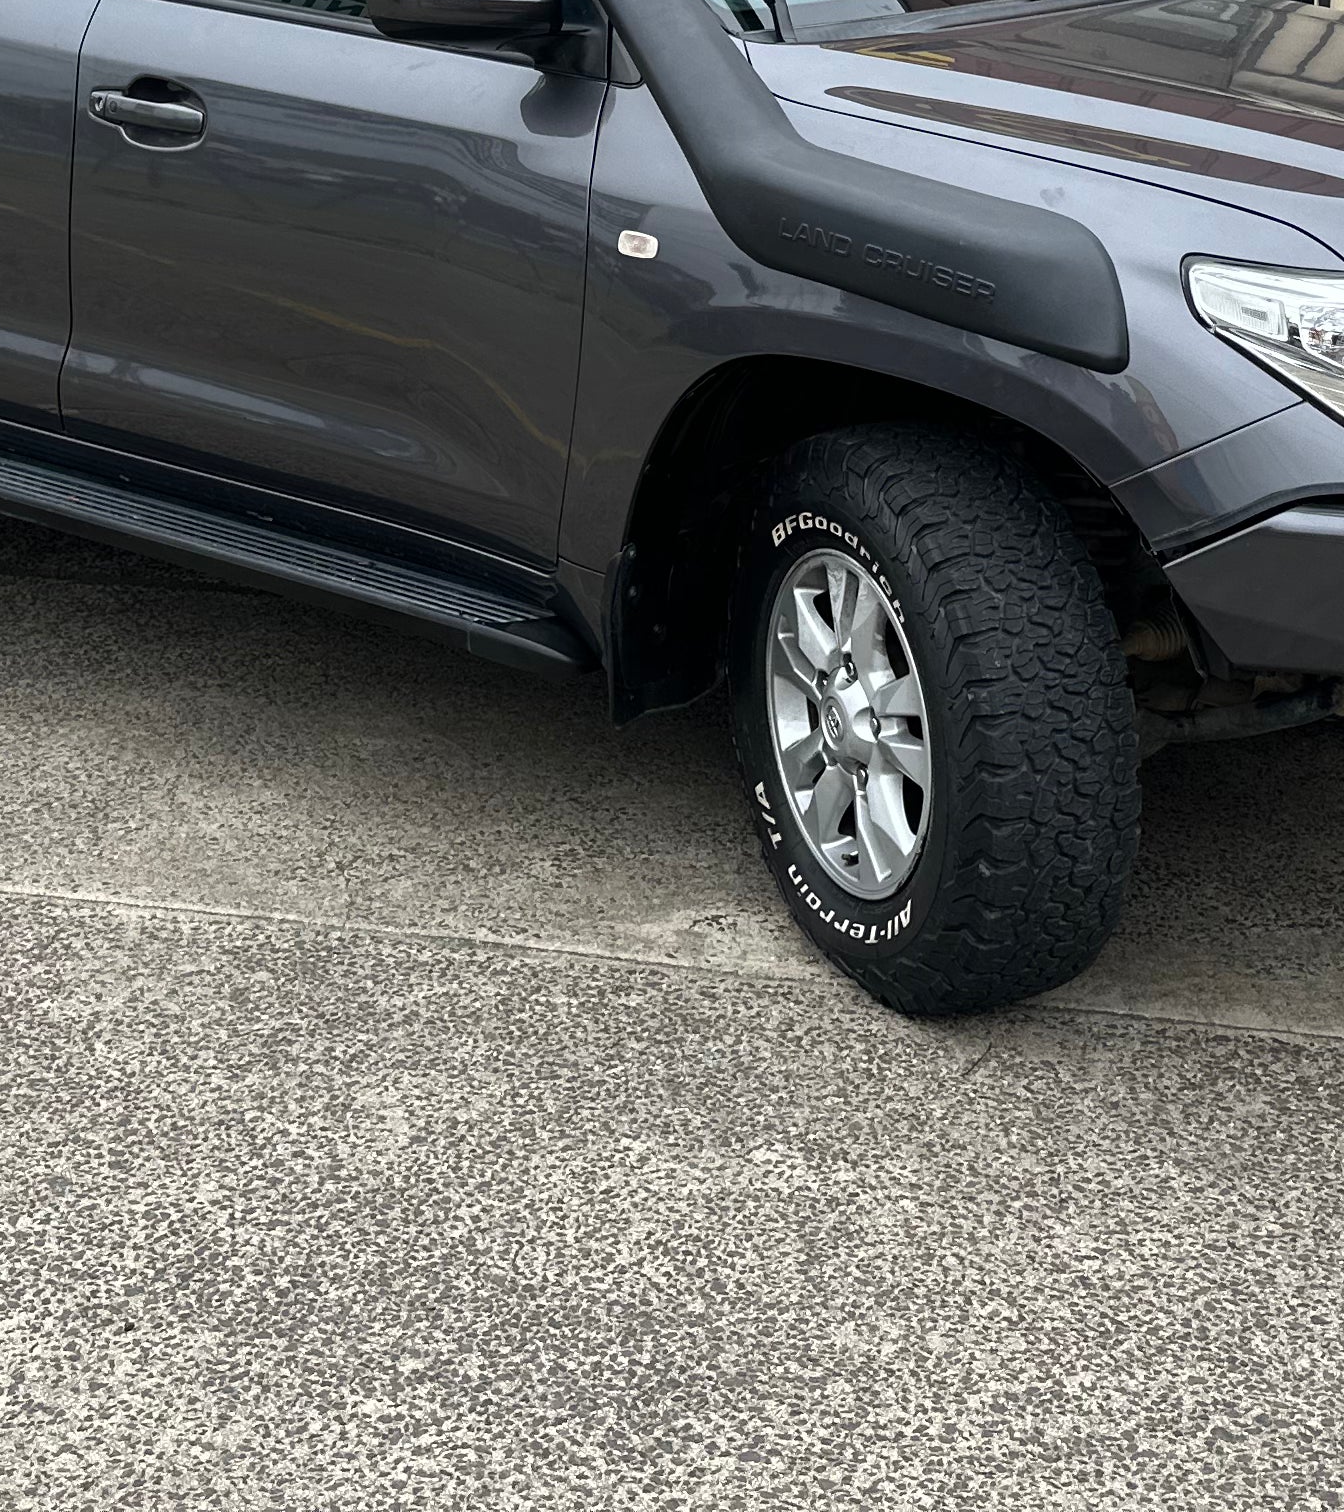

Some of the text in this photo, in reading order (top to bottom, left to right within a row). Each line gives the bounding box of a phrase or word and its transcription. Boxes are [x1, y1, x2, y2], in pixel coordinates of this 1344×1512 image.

[778, 217, 996, 304] LAND CRUISER
[771, 512, 905, 623] BFGoodrich
[754, 781, 782, 850] T/A
